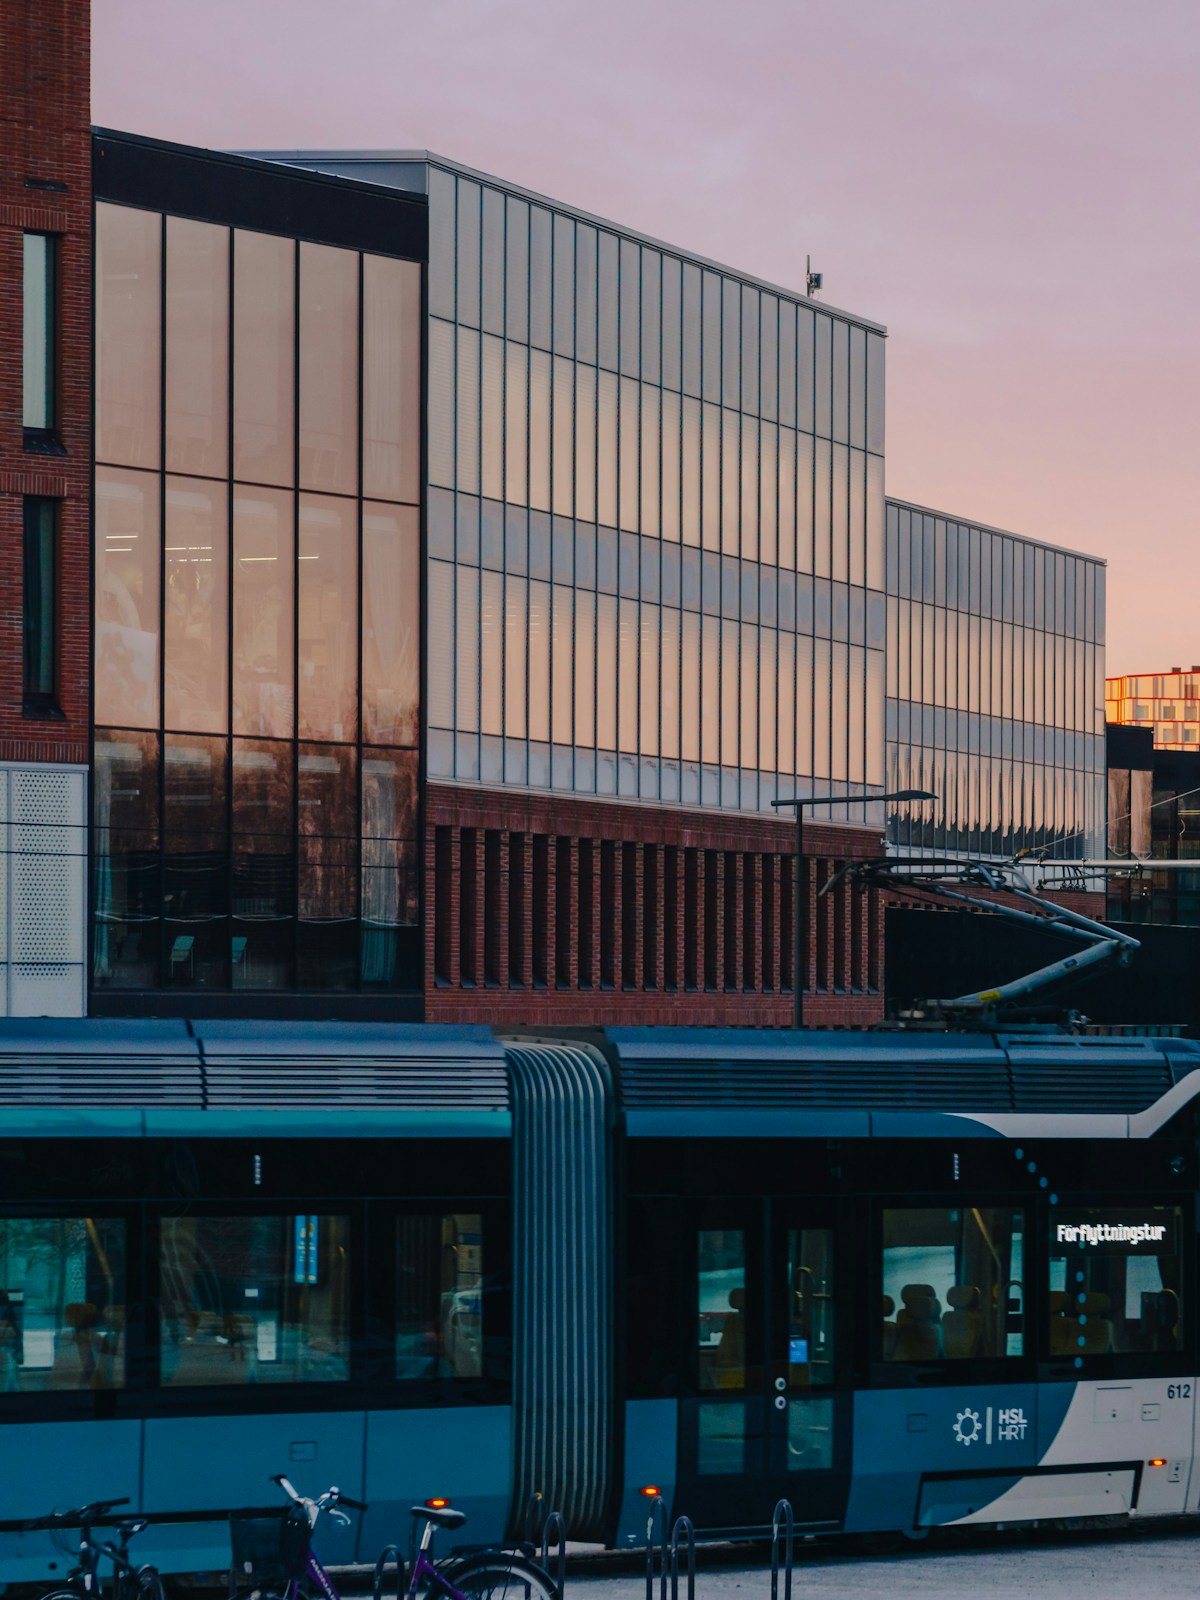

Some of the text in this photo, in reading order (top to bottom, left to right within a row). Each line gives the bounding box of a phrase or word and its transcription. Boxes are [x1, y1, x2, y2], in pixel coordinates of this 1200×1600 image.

[1056, 1223, 1167, 1246] Förflyttningstur
[1167, 1384, 1191, 1399] 612
[998, 1408, 1028, 1424] HSL
[998, 1424, 1028, 1440] HRT
